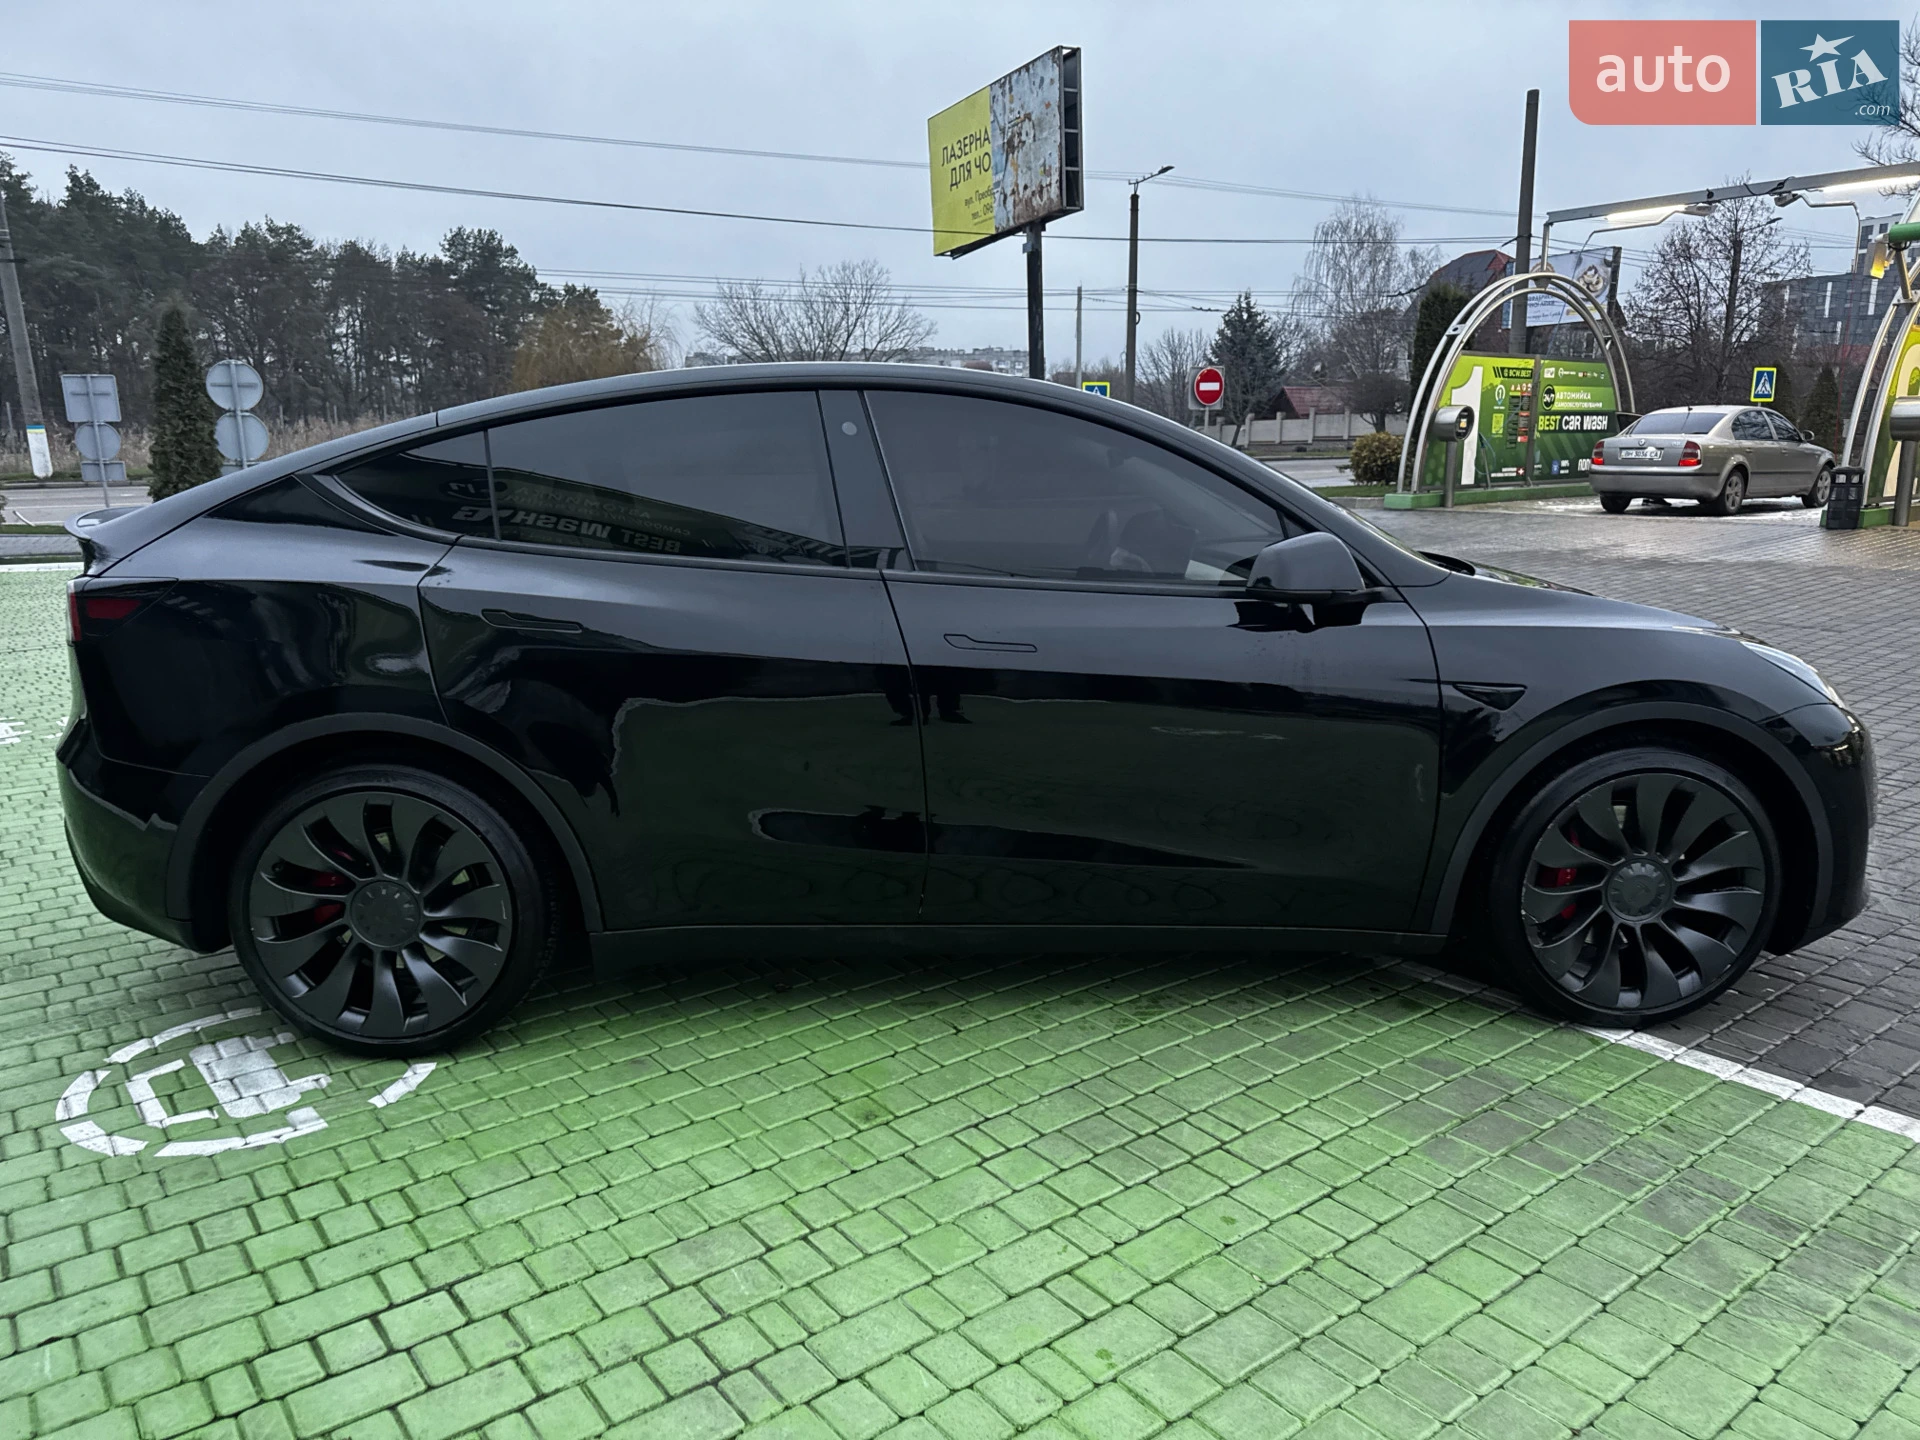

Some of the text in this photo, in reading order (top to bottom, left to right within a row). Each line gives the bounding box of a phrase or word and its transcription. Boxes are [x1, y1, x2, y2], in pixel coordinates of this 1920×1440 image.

[941, 125, 991, 168] ЛАЗЕРНА
[949, 151, 991, 192] ДЛЯ ЧО
[1556, 390, 1591, 400] АВТОМИЙКА
[1538, 415, 1561, 430] BEST
